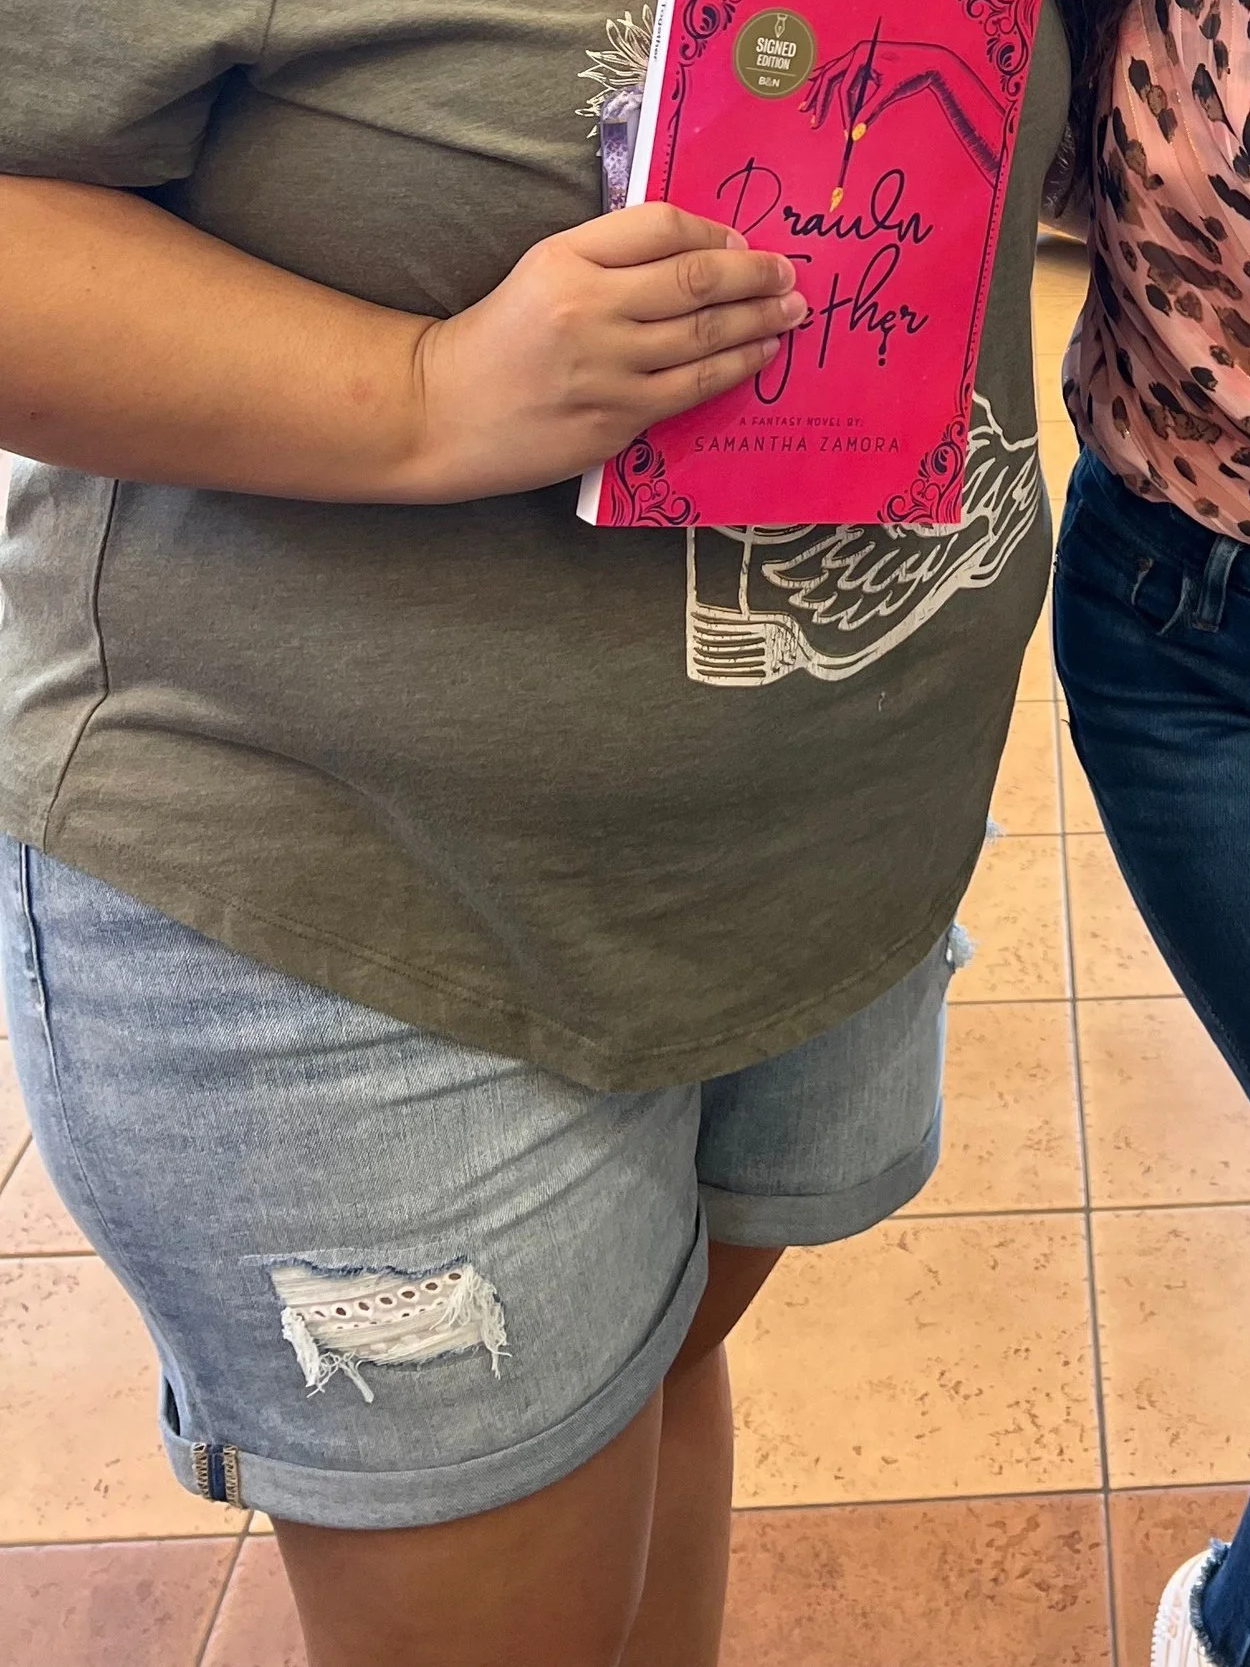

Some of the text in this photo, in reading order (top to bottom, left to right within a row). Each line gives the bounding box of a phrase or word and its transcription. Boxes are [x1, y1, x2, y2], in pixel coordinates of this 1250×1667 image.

[756, 37, 797, 57] SIGNED
[756, 54, 791, 70] EDITION
[758, 76, 780, 87] B&N
[717, 157, 933, 244] Drawn
[739, 417, 746, 426] A
[751, 416, 802, 426] FANTASY
[807, 417, 841, 426] NOVEL
[694, 436, 900, 452] SAMANTHA ZAMORA
